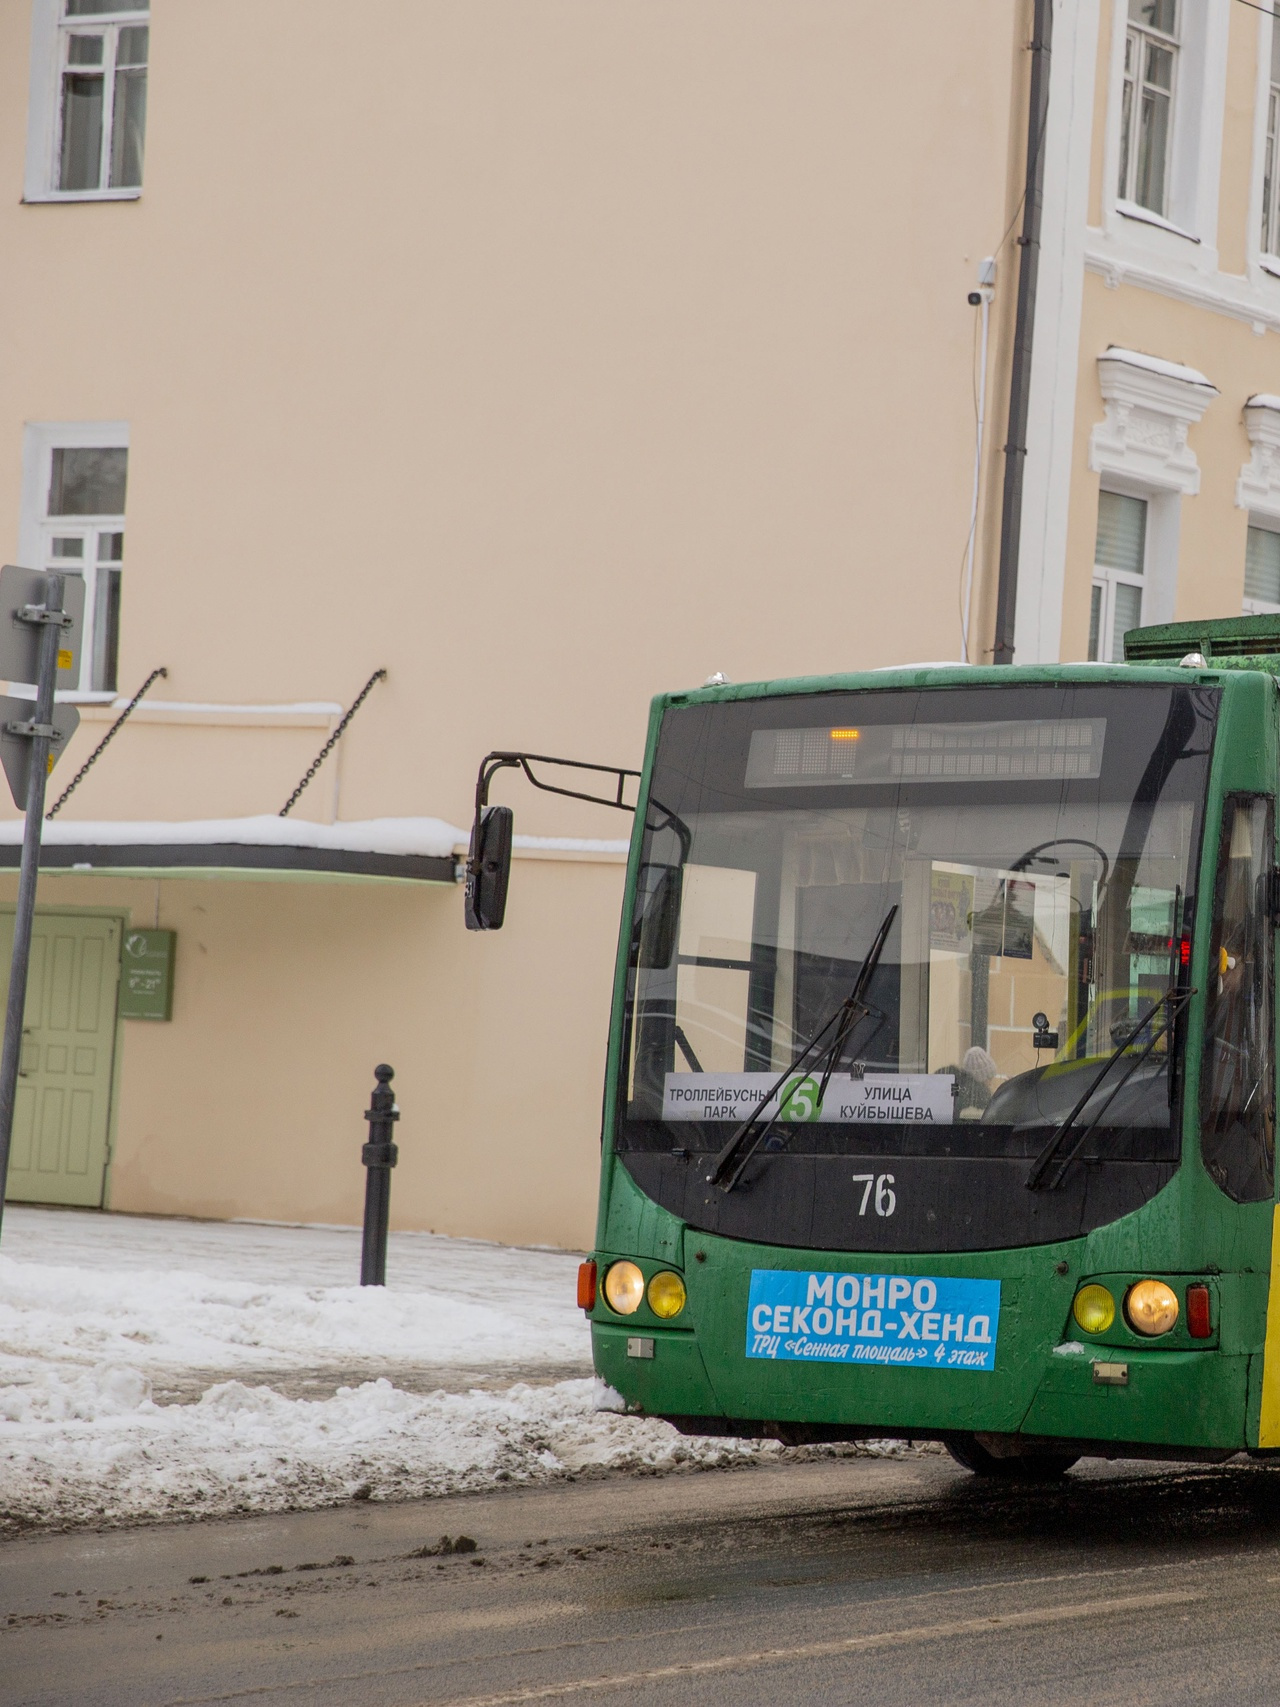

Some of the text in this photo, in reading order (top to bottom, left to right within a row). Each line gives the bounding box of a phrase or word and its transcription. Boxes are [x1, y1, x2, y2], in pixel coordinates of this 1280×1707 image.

[703, 1103, 934, 1120] ПАРК КУЙБЫШЕВА
[789, 1083, 813, 1122] 5
[864, 1086, 912, 1103] УЛИЦА
[853, 1174, 897, 1217] 76
[806, 1274, 938, 1312] МОНРО
[751, 1304, 992, 1344] СЕКОНД-ХЕНД
[751, 1334, 989, 1367] ТРЦ «Сенная площадь» 4 этаж
